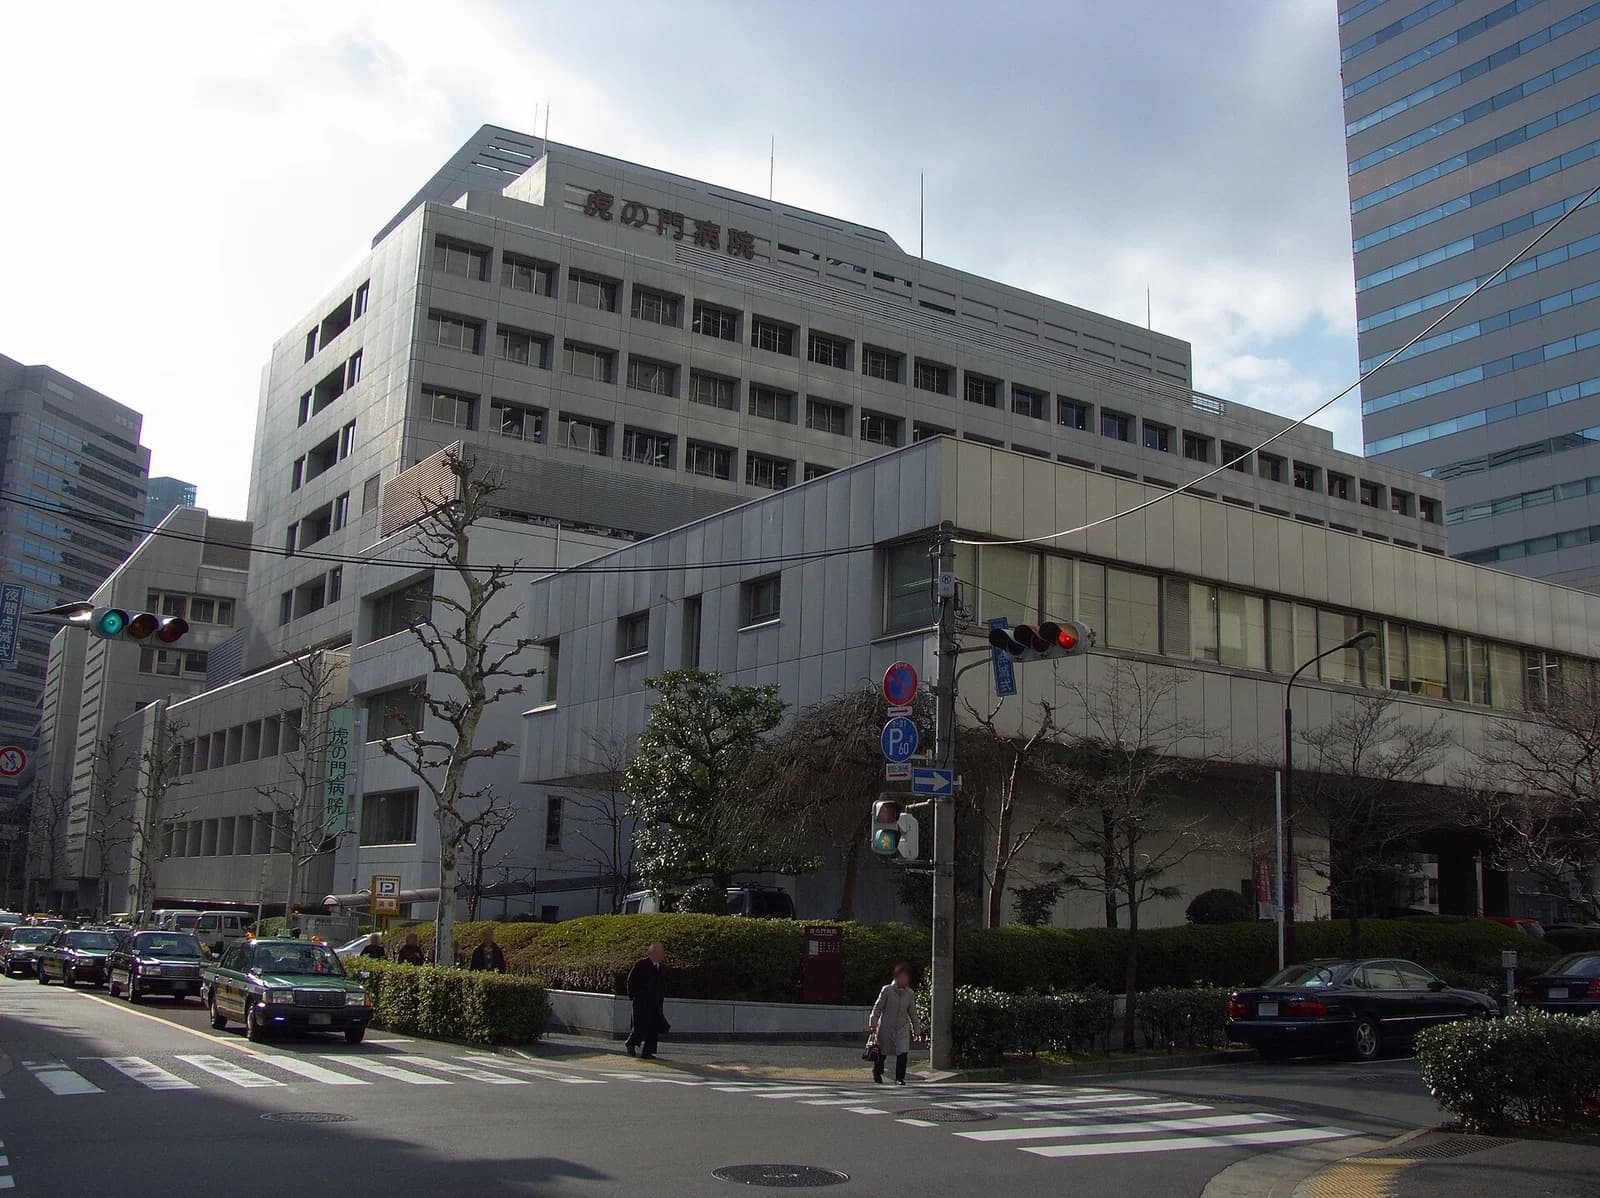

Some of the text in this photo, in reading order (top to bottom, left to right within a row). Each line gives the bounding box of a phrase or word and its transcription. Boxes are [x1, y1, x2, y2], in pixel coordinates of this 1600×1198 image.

[583, 189, 756, 260] 虎の門病院
[889, 728, 904, 756] P
[899, 742, 910, 755] 60
[328, 728, 349, 815] 虎の門病院
[381, 883, 394, 893] P
